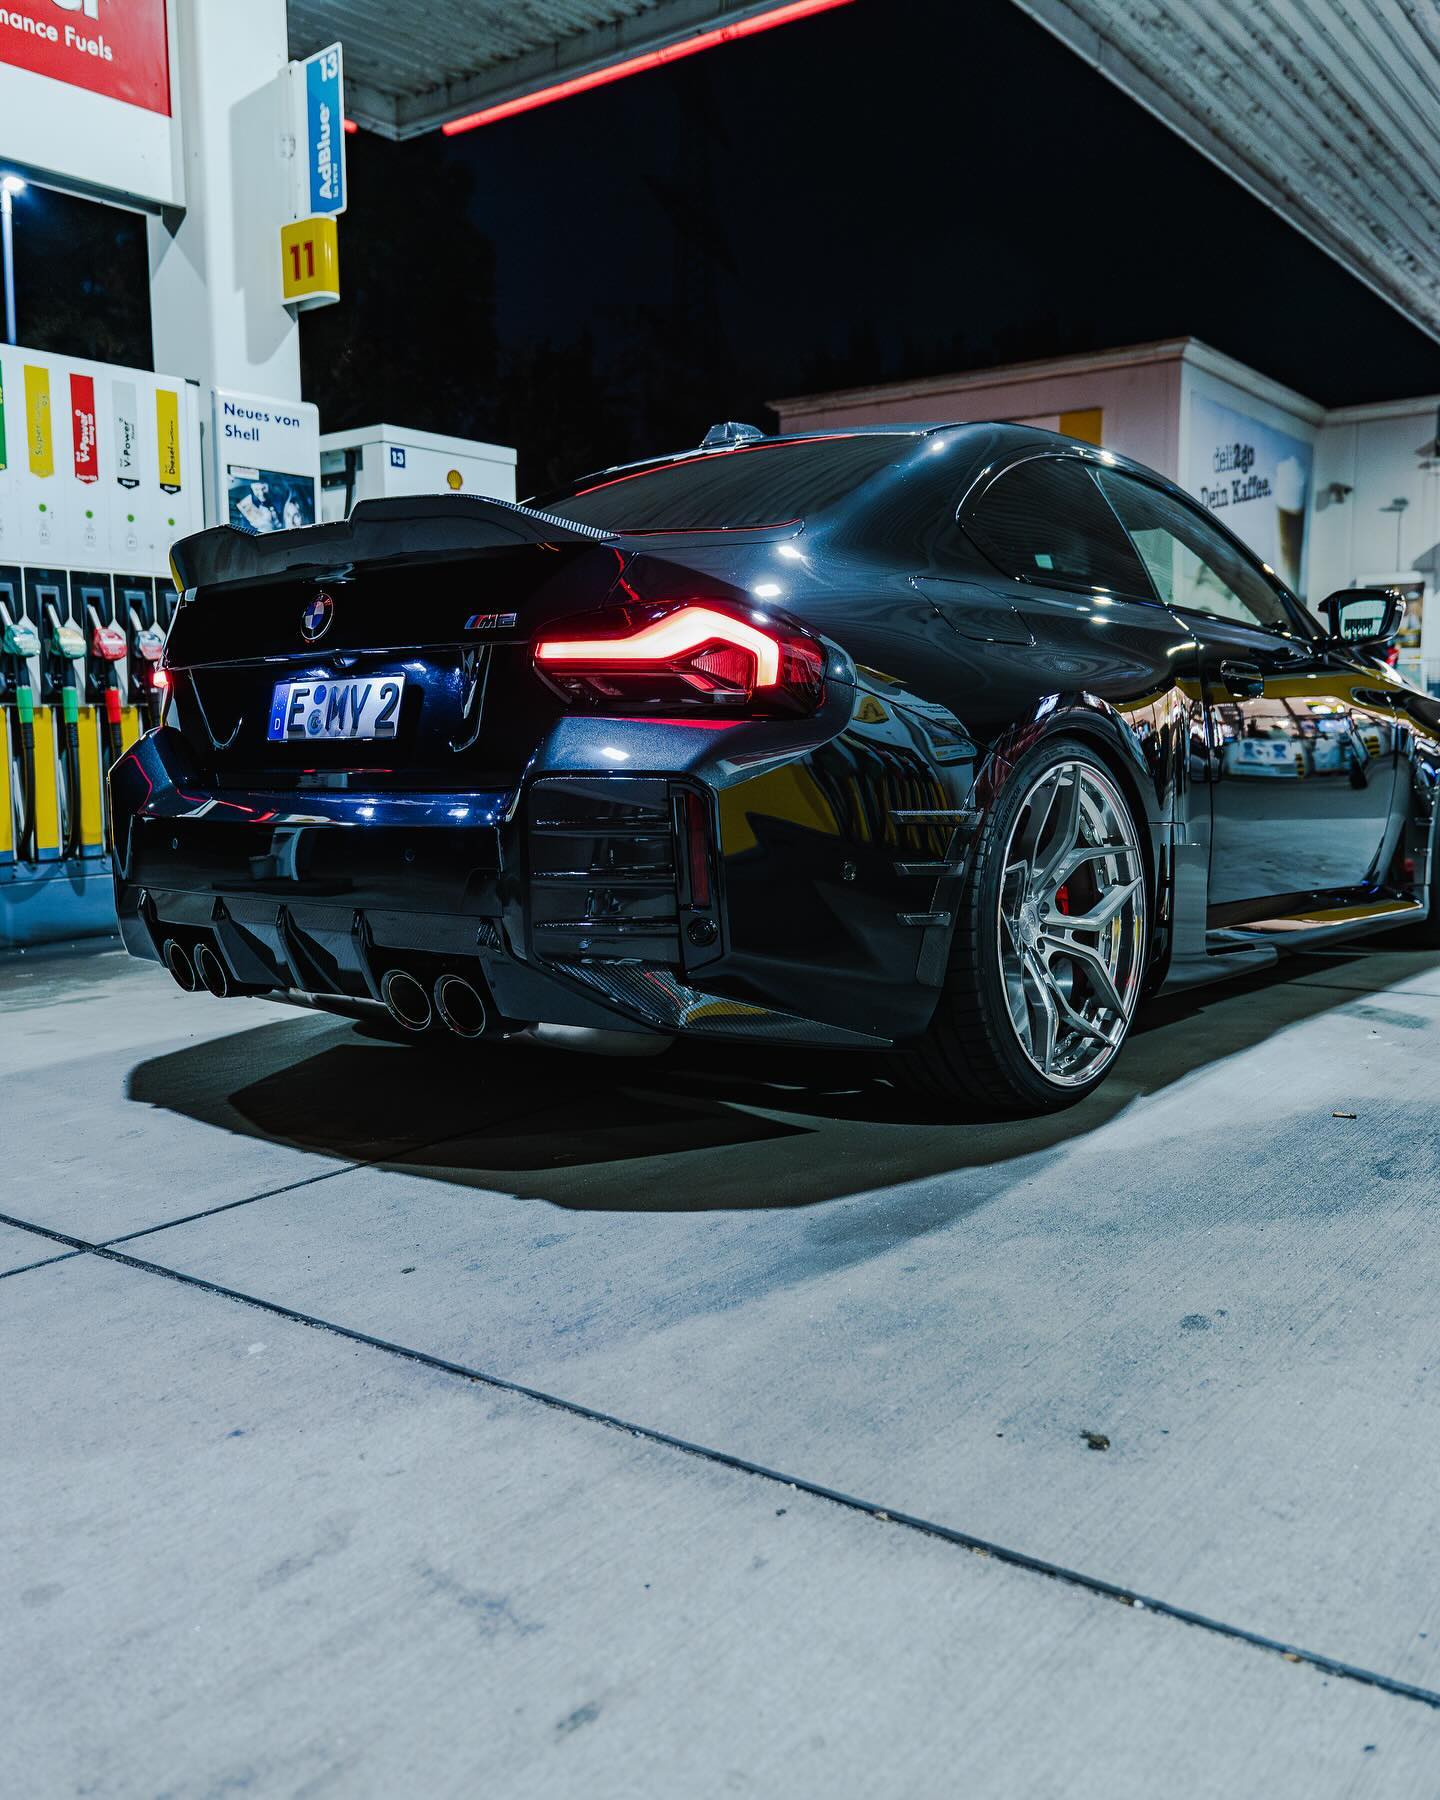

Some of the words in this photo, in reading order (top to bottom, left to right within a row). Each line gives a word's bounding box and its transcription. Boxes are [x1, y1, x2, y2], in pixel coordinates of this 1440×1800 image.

[64, 24, 113, 61] Fuels
[319, 52, 338, 82] 13
[290, 240, 315, 282] 11
[224, 402, 270, 422] Neues
[274, 415, 300, 428] von
[224, 424, 260, 442] Shell
[391, 450, 405, 466] 13
[1200, 483, 1229, 509] Dein
[465, 612, 517, 630] M2
[286, 687, 311, 732] E
[324, 684, 373, 733] MY
[374, 682, 400, 730] 2
[274, 718, 281, 731] D
